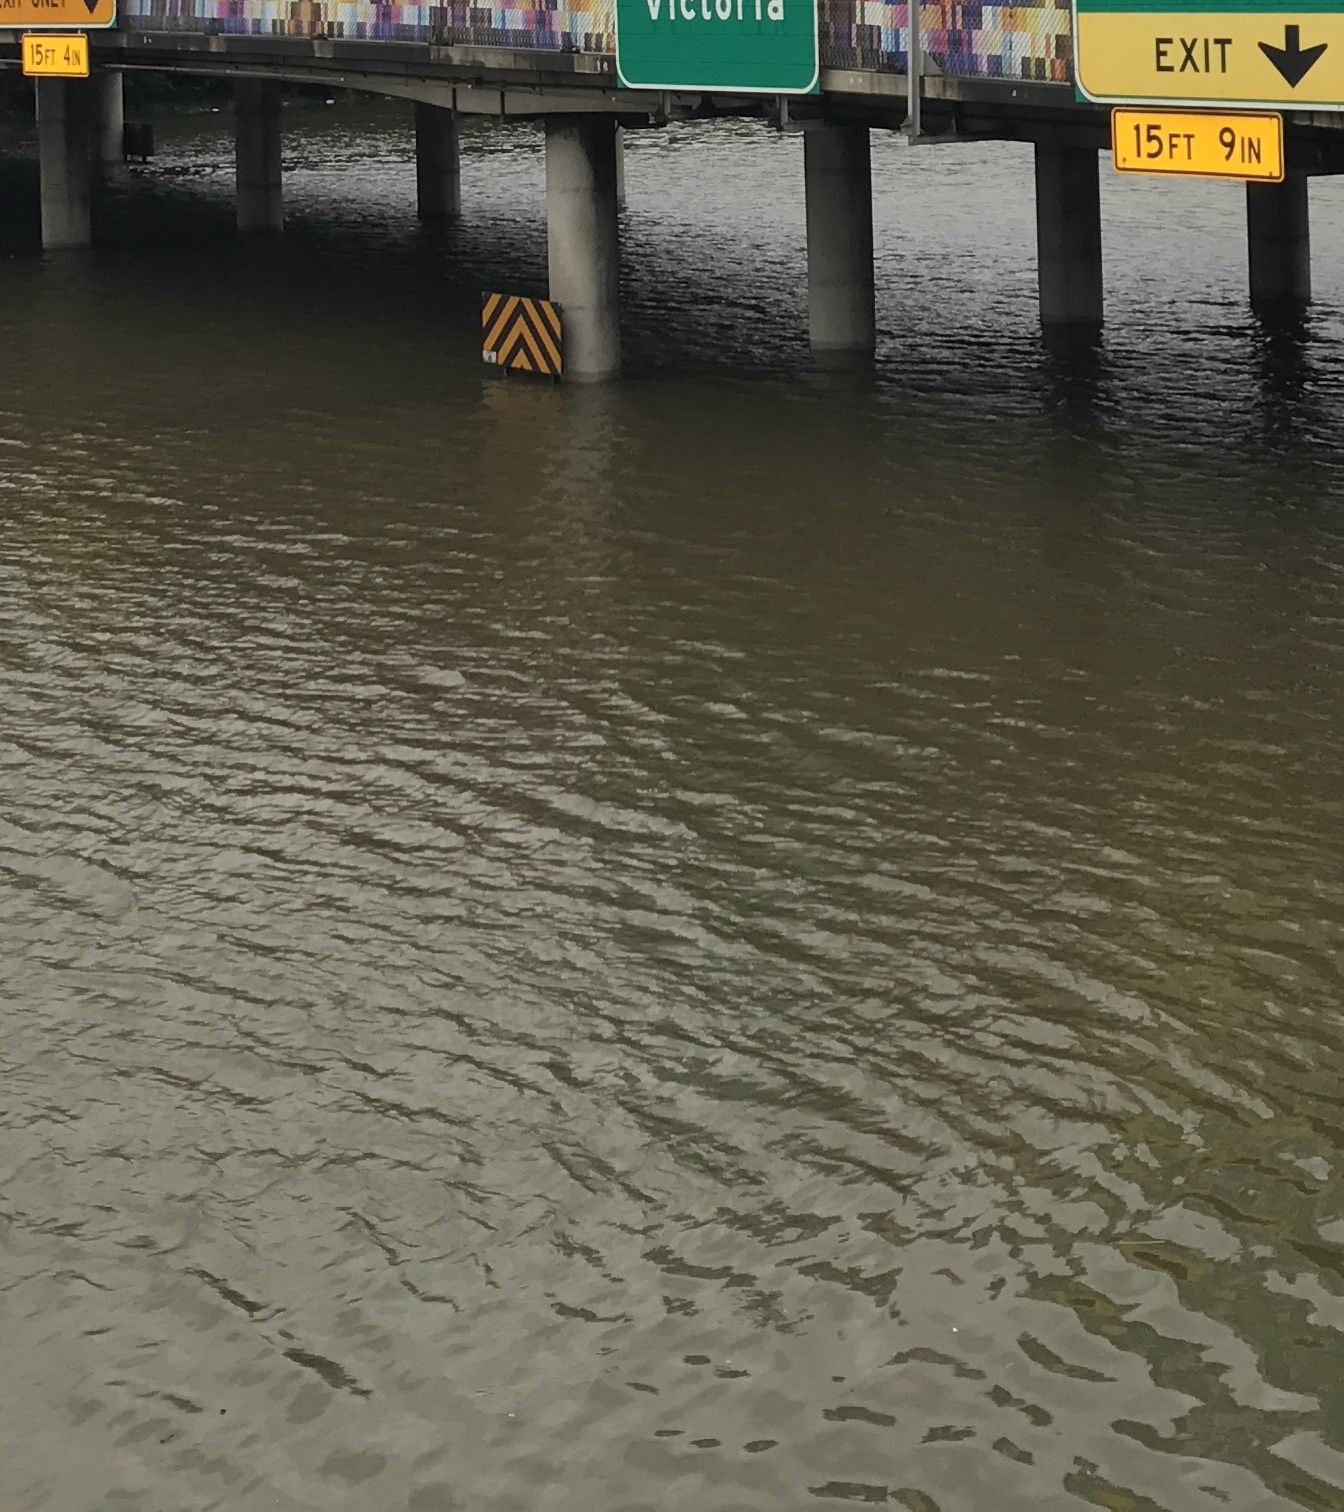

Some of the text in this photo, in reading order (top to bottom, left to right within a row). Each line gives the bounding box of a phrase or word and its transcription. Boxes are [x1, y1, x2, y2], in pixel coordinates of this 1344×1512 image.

[30, 43, 56, 66] 15FT
[1155, 37, 1233, 74] EXIT
[1133, 122, 1261, 165] 15FT 9IN
